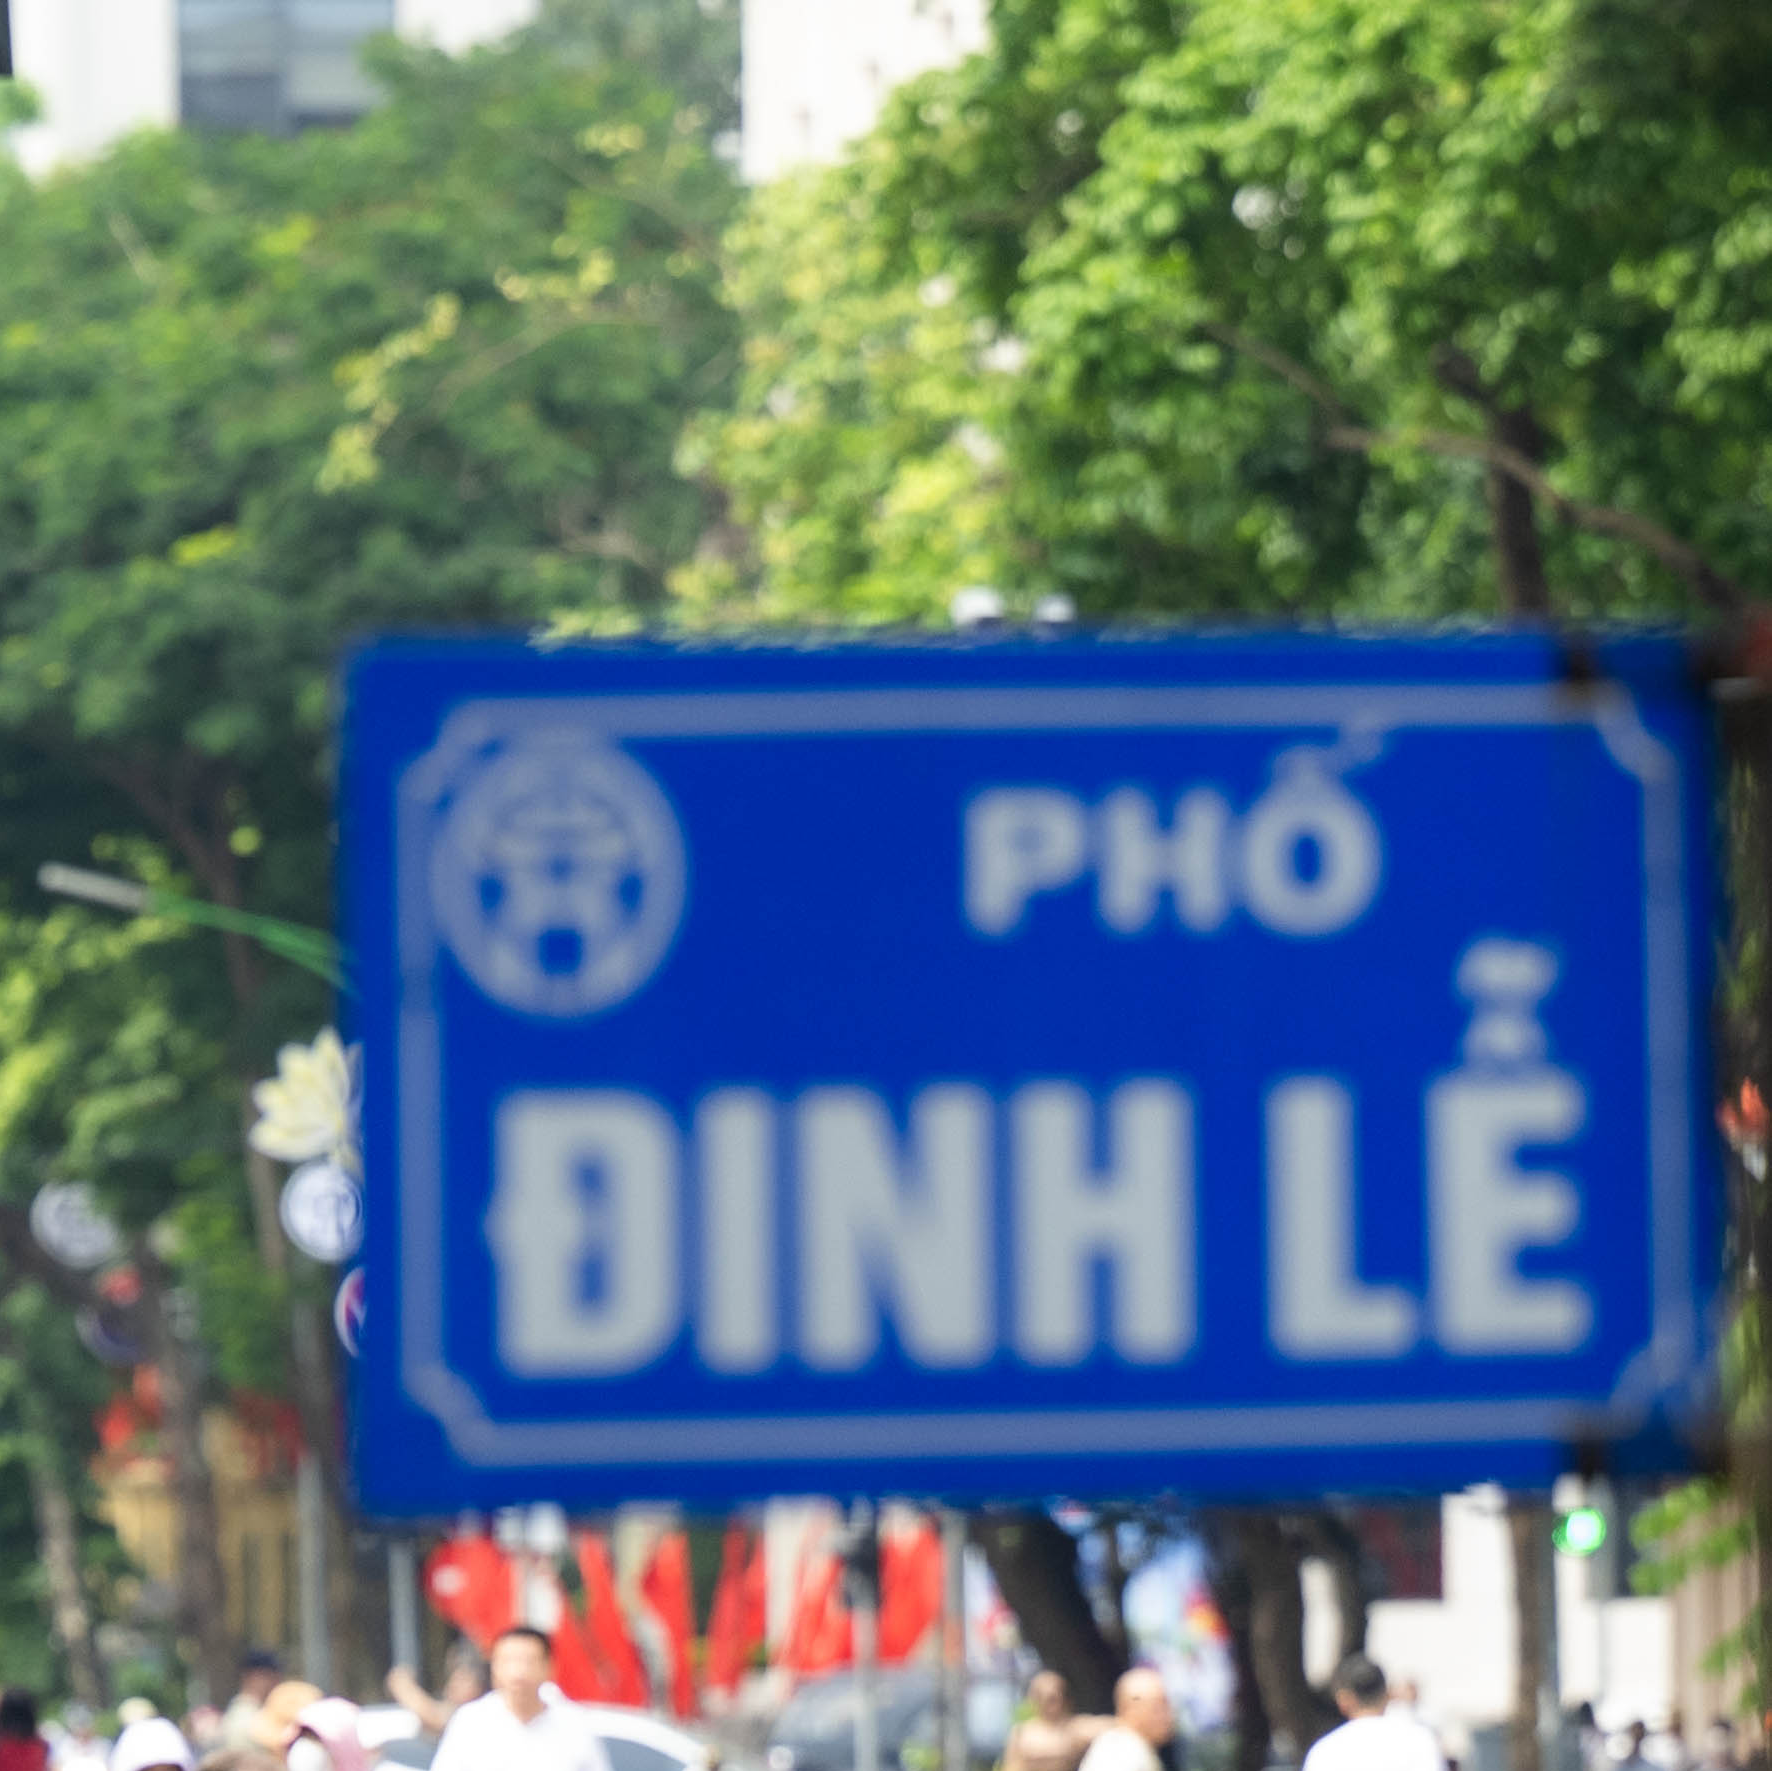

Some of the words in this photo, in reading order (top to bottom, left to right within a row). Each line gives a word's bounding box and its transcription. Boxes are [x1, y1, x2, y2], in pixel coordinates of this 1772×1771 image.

[967, 718, 1381, 934] PHỐ
[490, 1086, 1193, 1372] ĐINH
[1269, 940, 1588, 1354] LỄ
